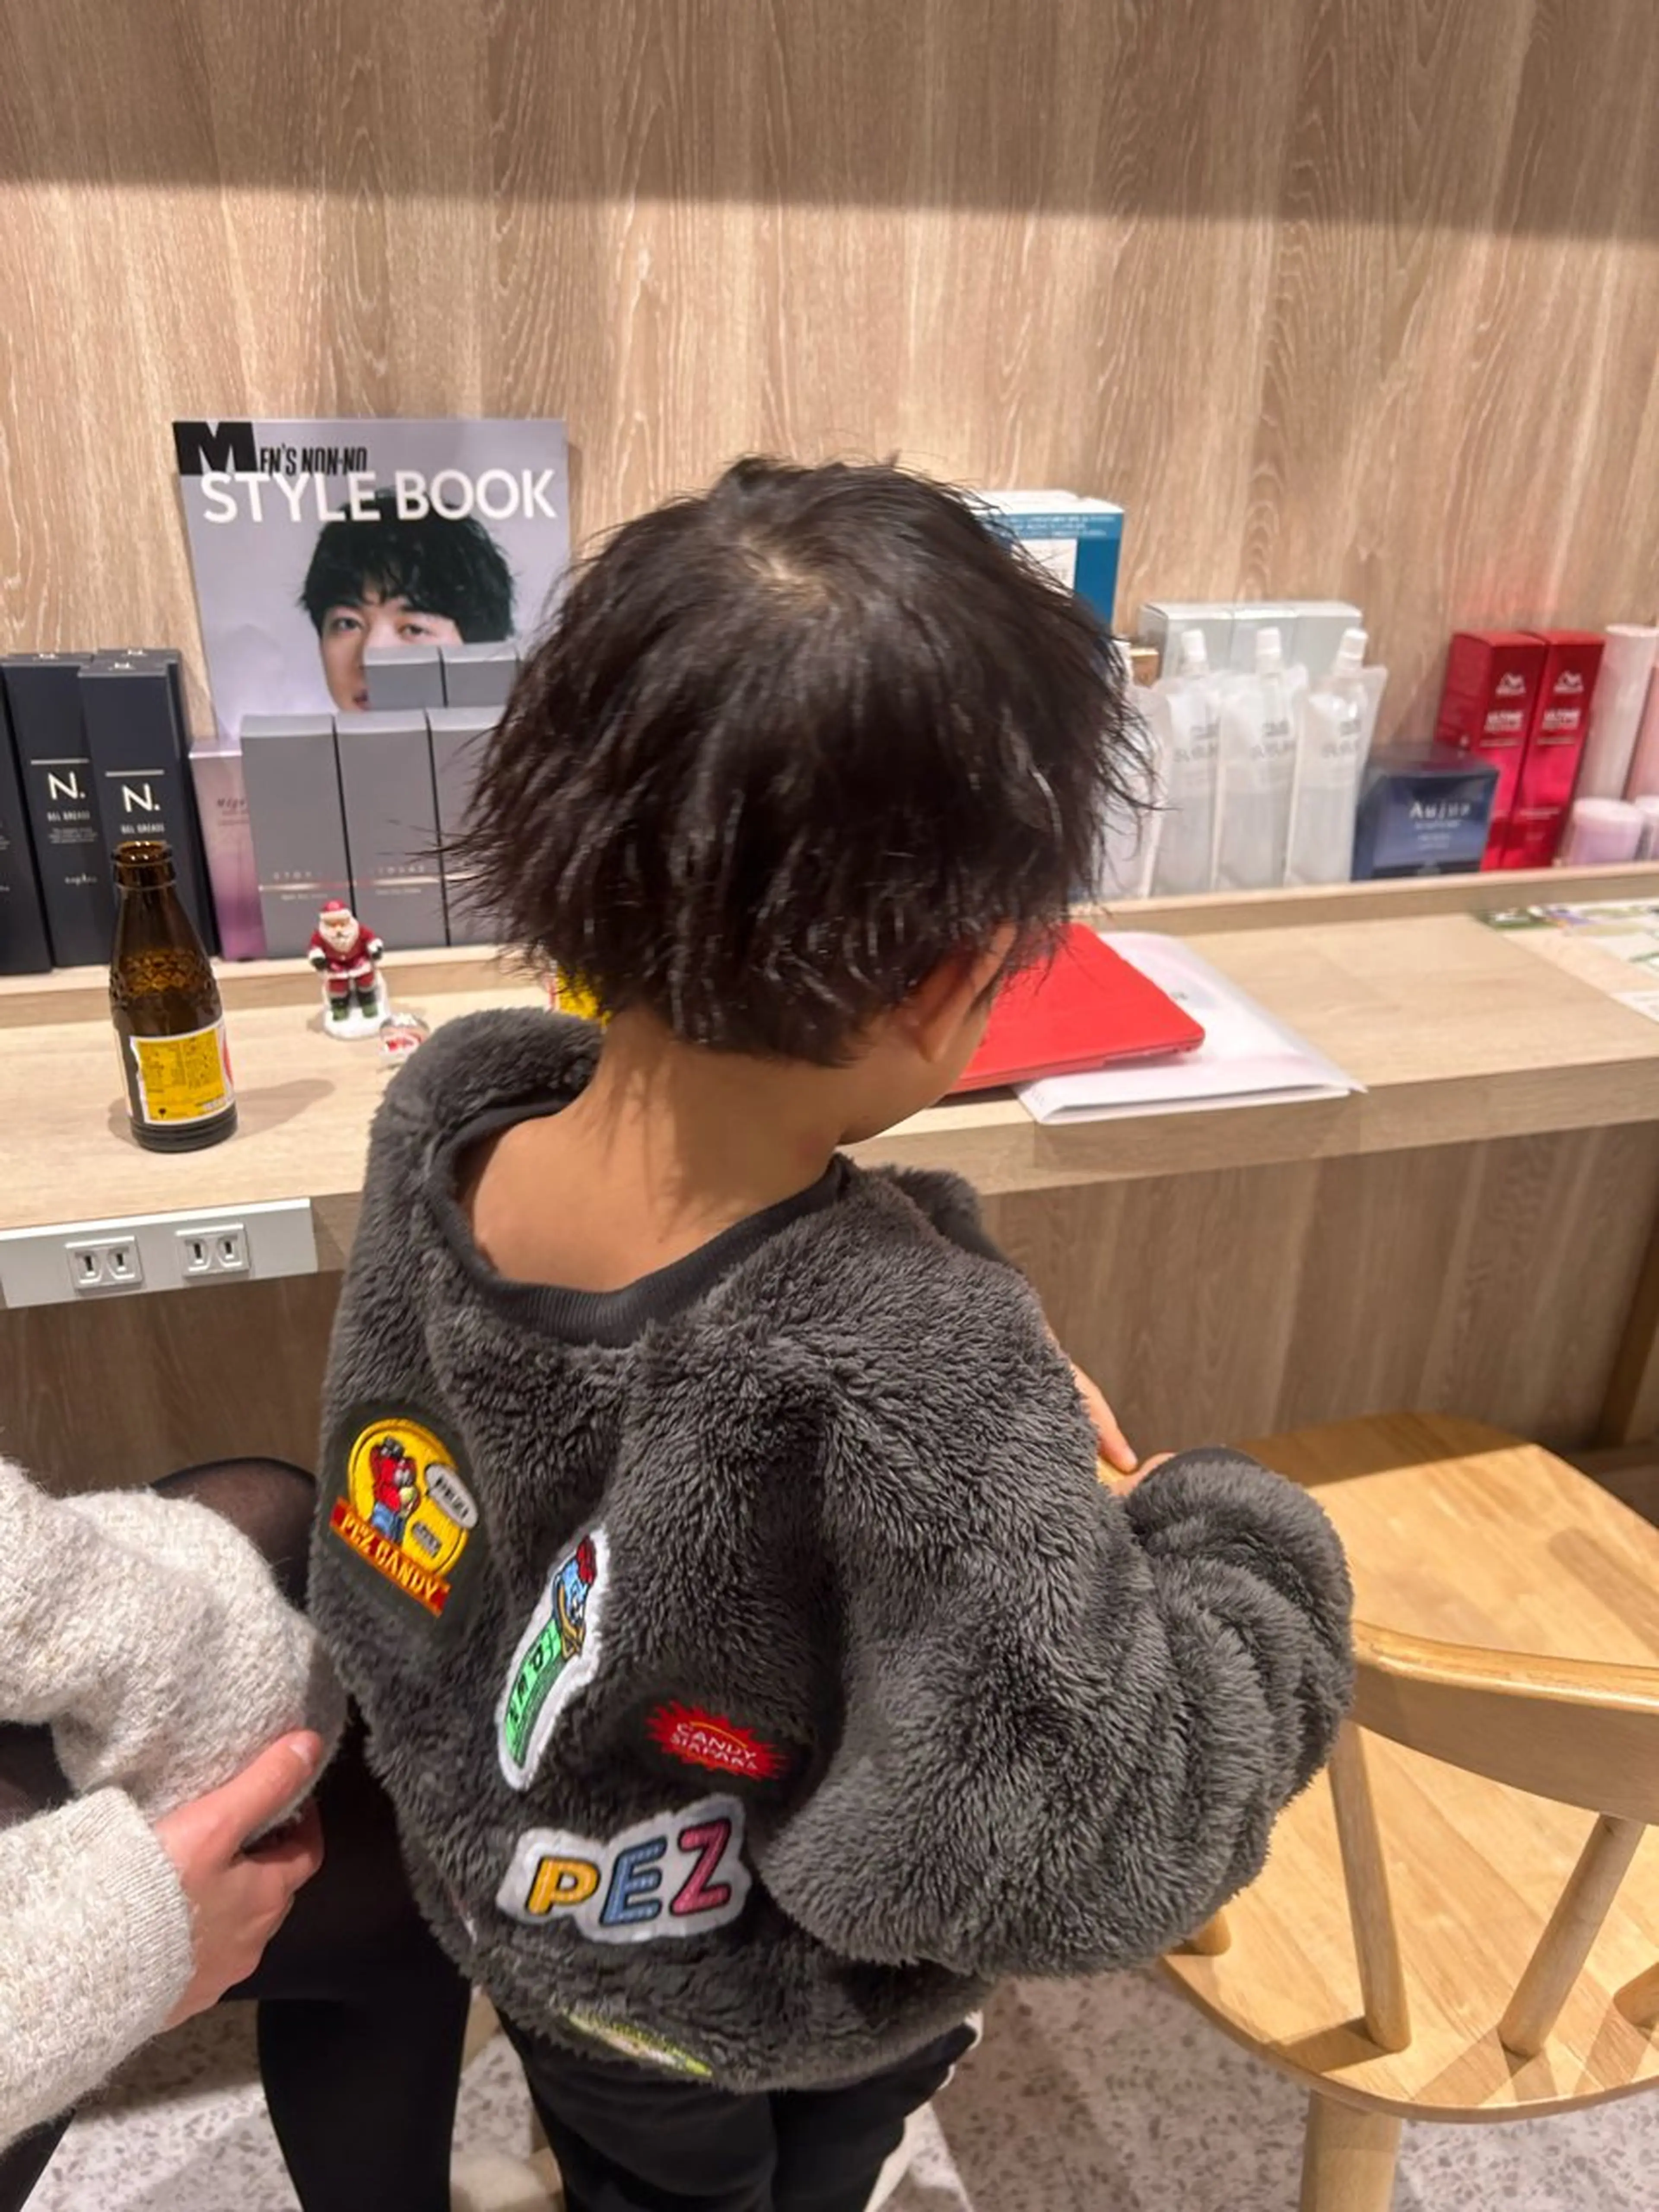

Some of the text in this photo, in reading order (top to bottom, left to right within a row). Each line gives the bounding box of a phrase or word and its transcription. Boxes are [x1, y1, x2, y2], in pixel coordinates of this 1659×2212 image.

[173, 422, 367, 477] MEN'S NON-NO
[200, 468, 558, 522] STYLE BOOK
[48, 770, 86, 800] N.
[122, 782, 160, 812] N.
[375, 1539, 440, 1600] CANDY
[676, 1723, 756, 1760] CANDY
[525, 1816, 733, 1926] PEZ
